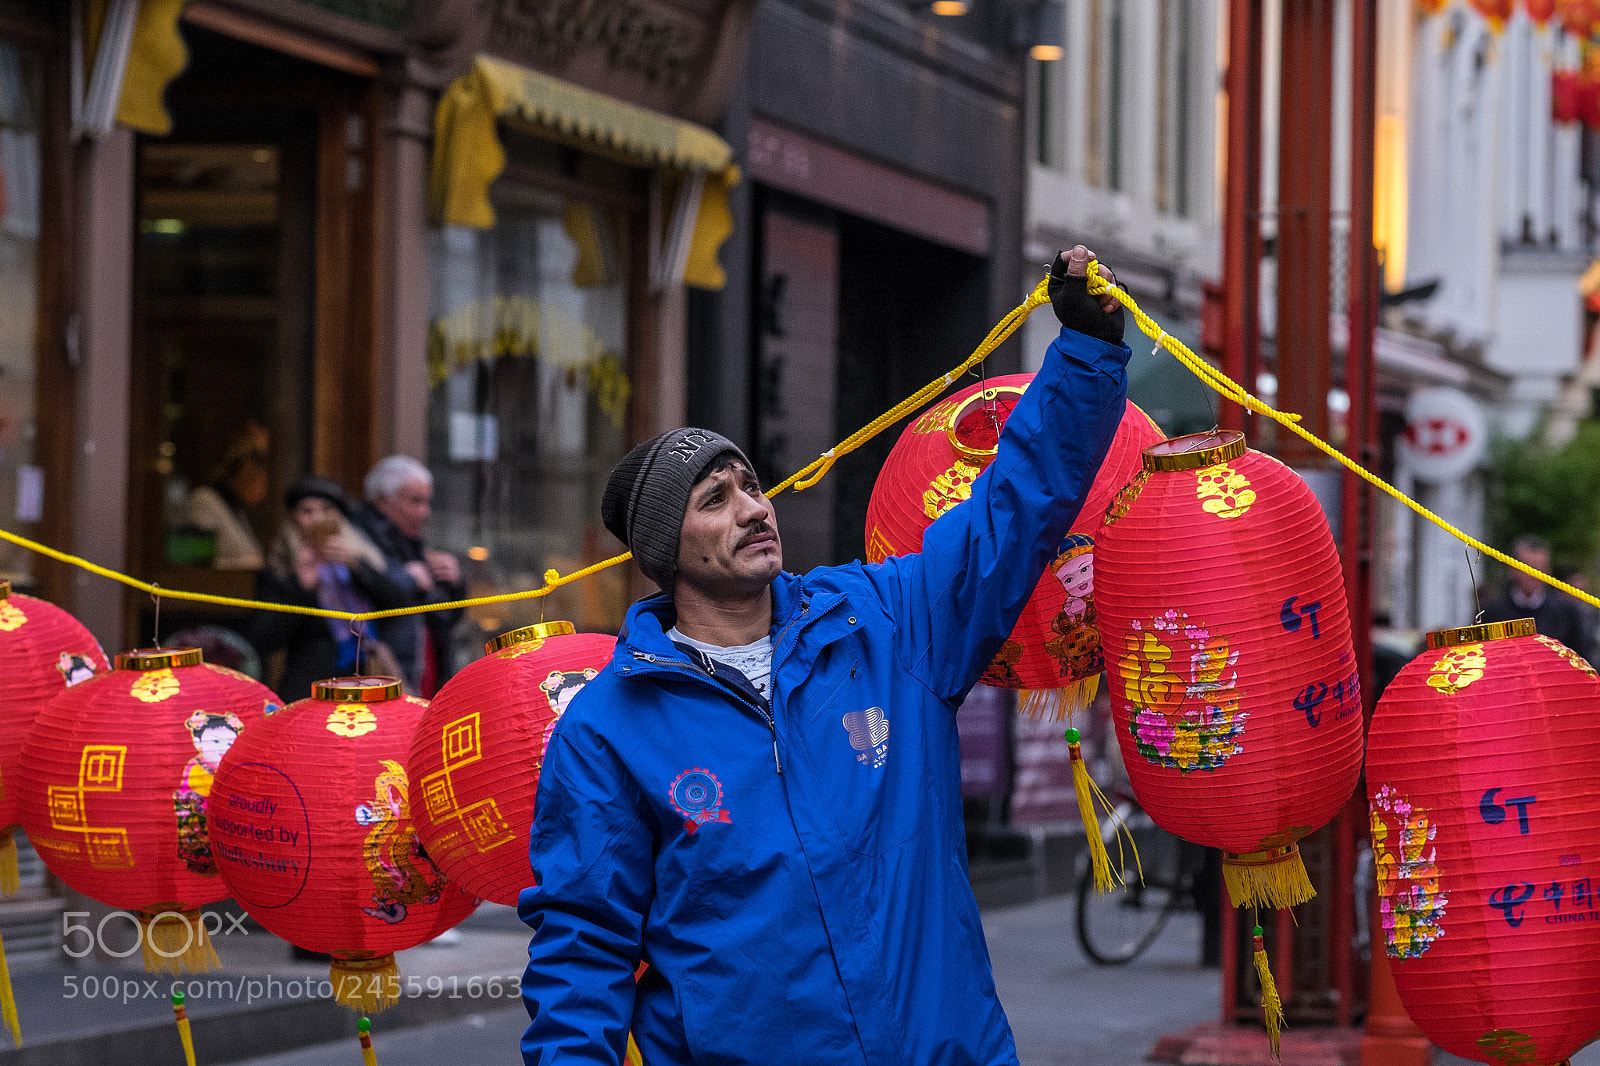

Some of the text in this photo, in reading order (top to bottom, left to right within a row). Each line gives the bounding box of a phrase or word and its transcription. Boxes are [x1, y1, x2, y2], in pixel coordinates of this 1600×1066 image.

[228, 794, 278, 819] proudly
[280, 826, 299, 847] by
[1545, 912, 1586, 924] CHINA
